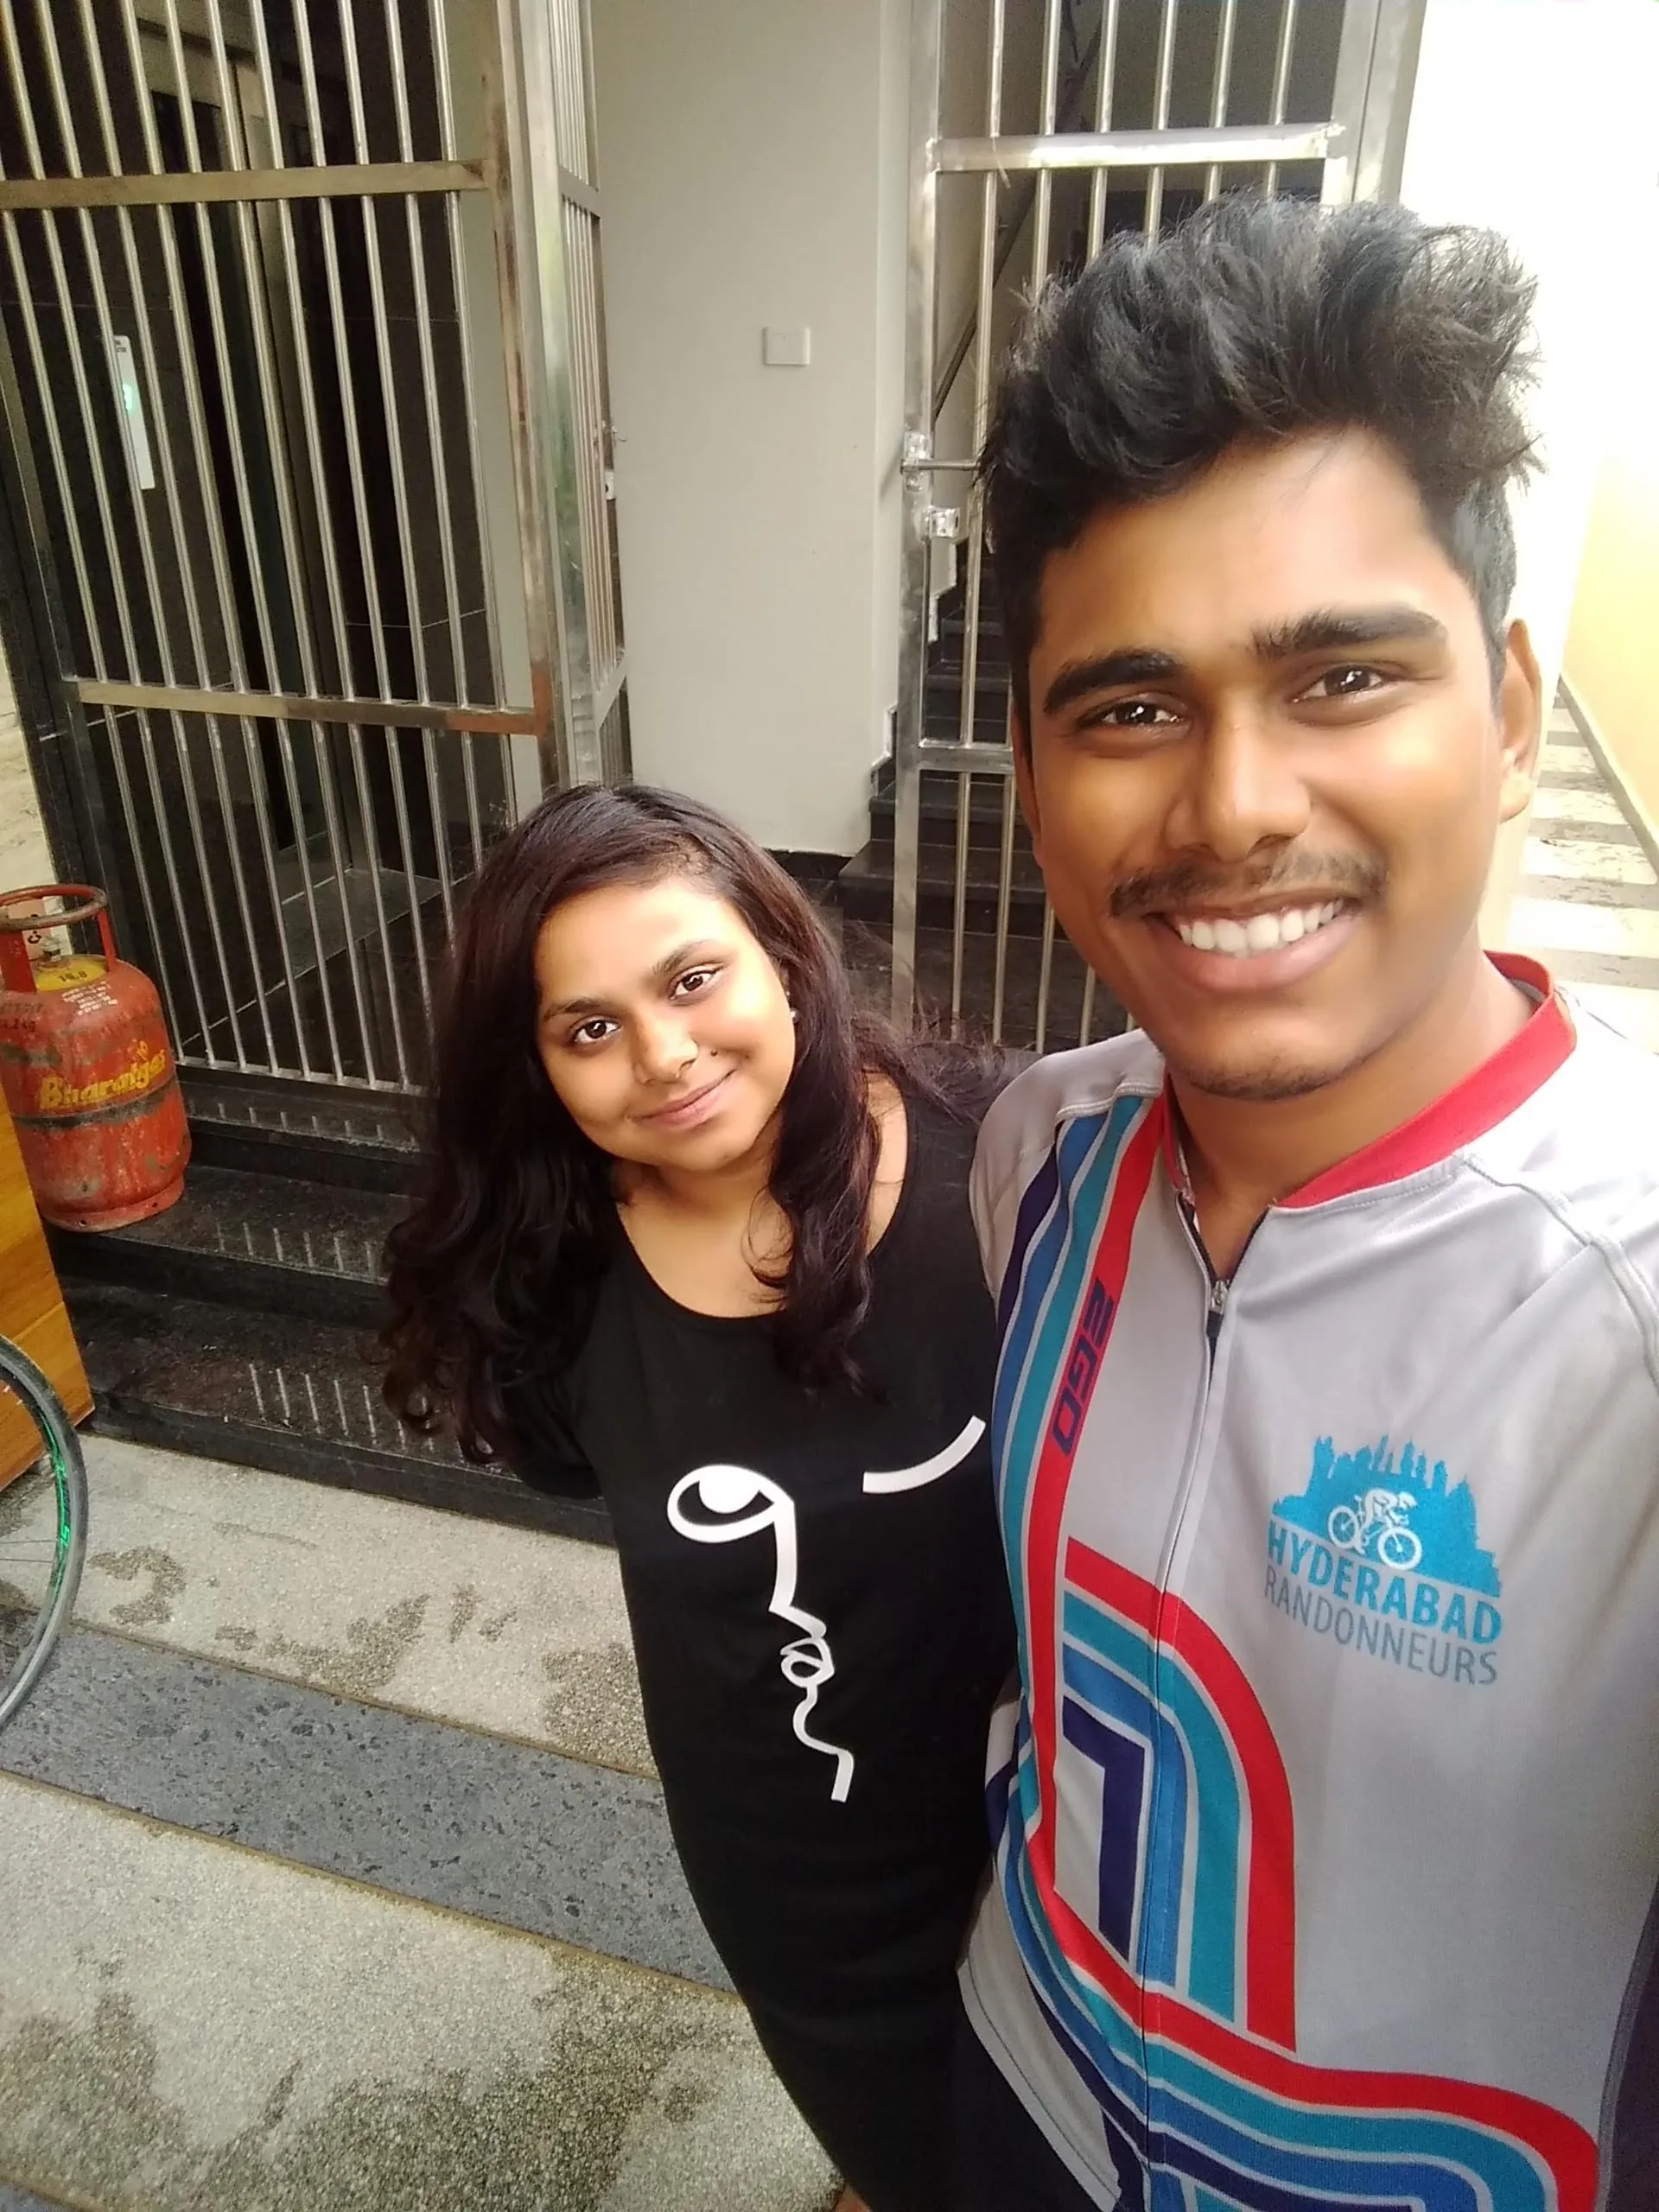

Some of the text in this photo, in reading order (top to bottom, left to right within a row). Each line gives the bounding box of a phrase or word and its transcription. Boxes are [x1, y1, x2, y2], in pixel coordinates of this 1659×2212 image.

[1052, 1277, 1114, 1457] EGO
[1264, 1565, 1498, 1686] RANDONNEURS
[1267, 1516, 1502, 1644] HYDERABAD
